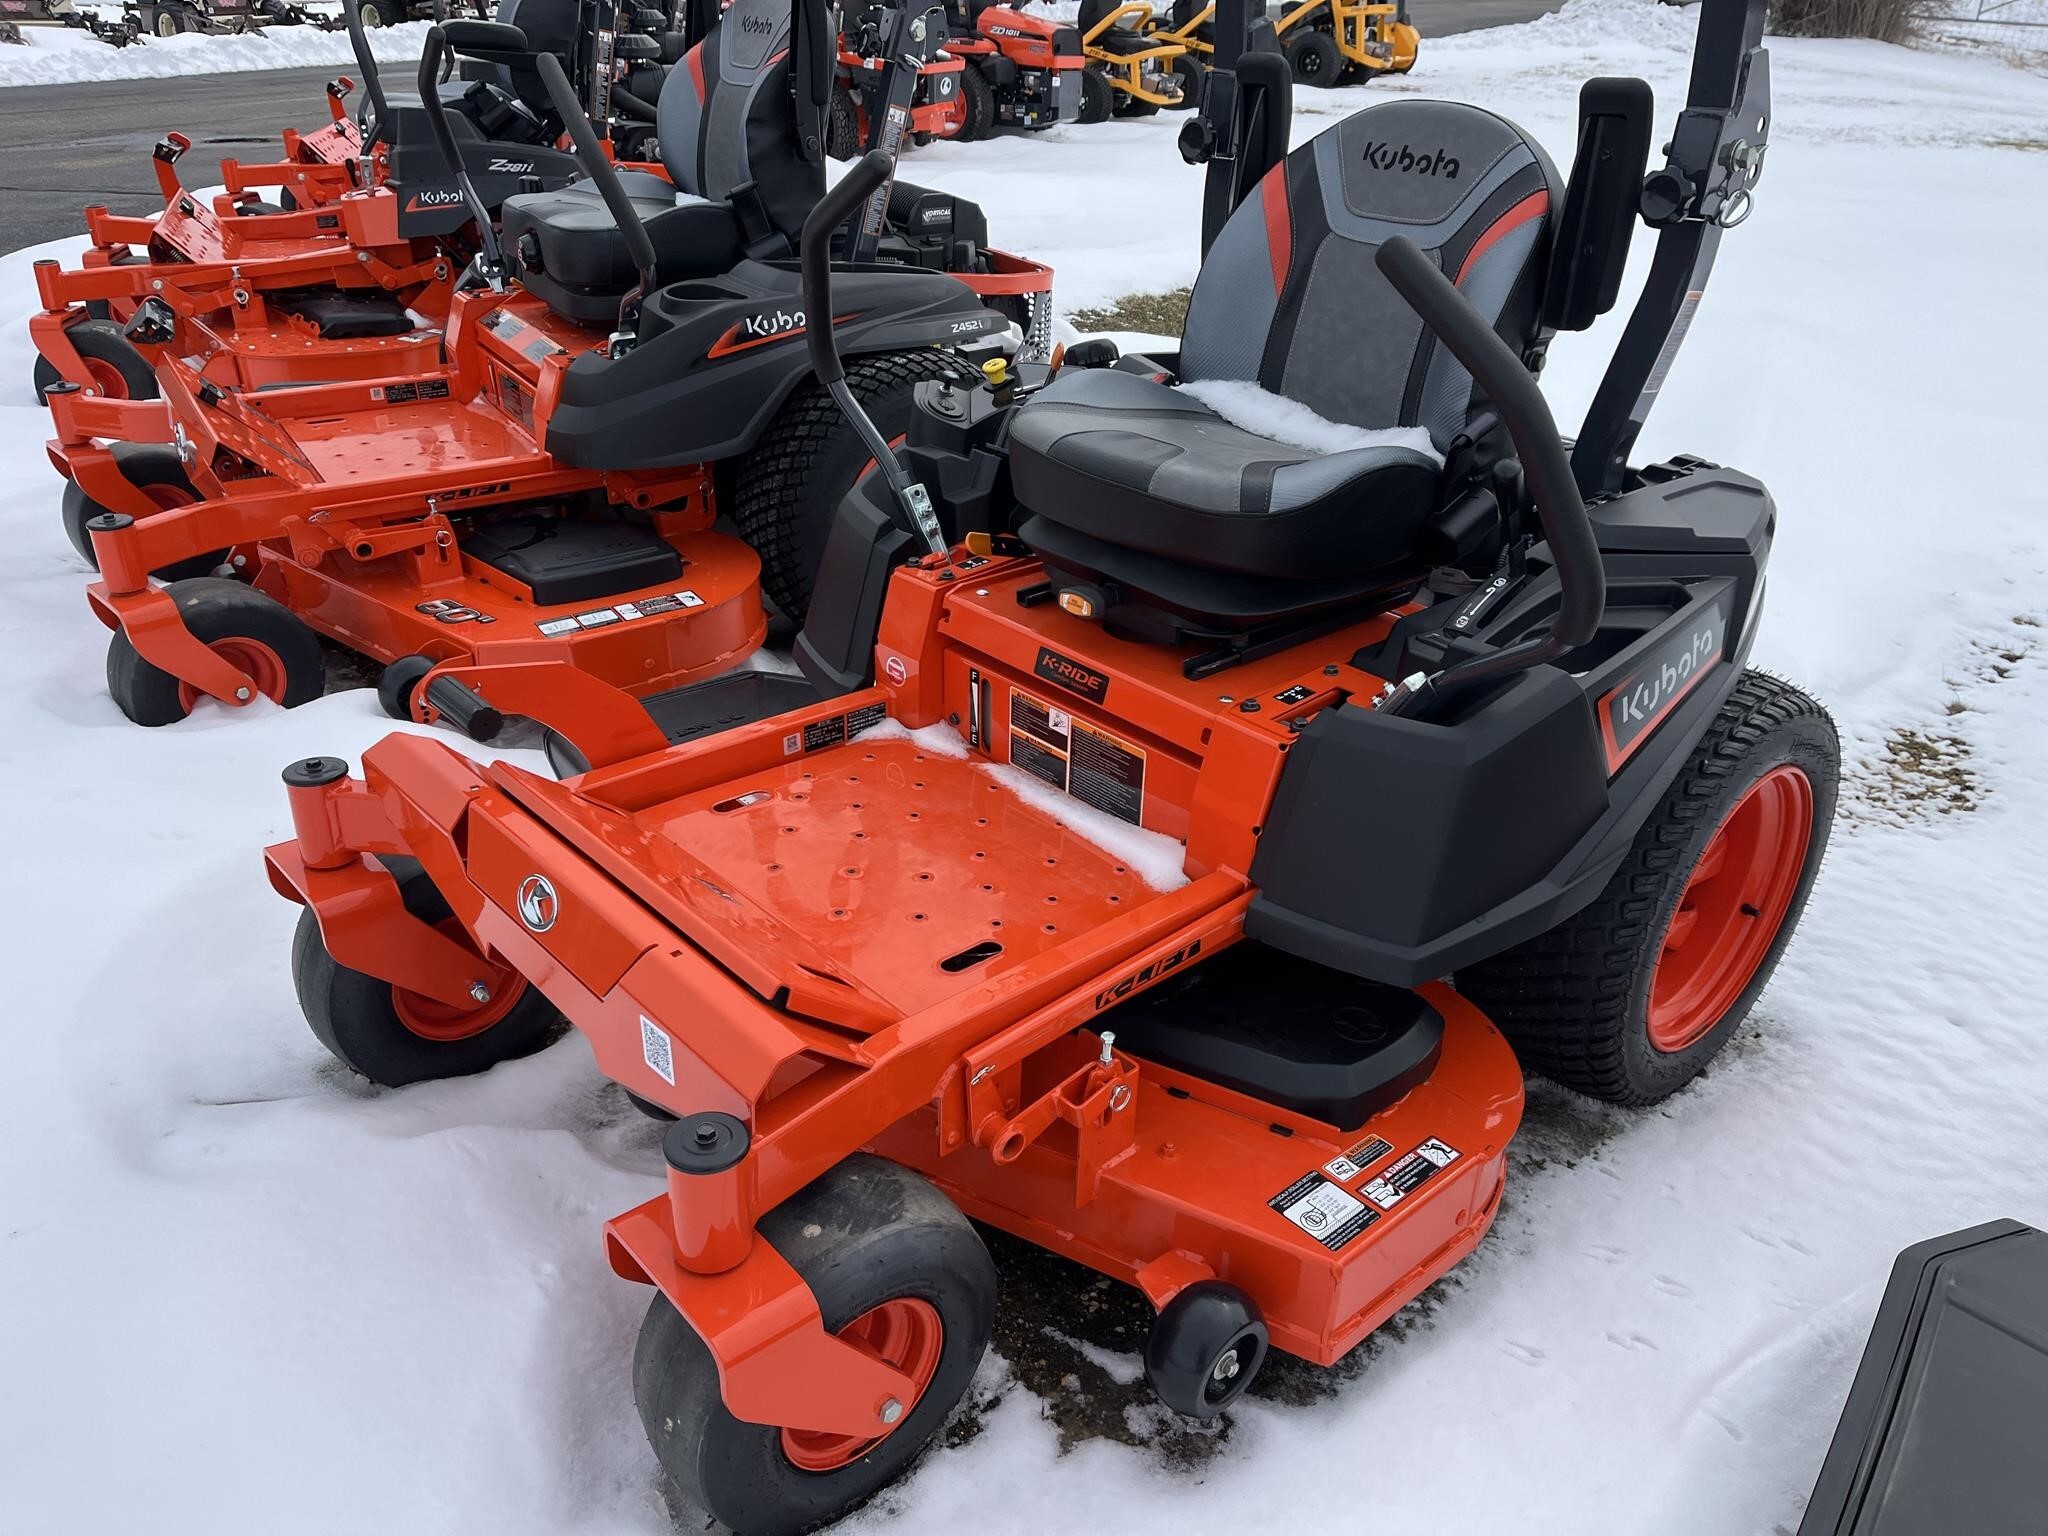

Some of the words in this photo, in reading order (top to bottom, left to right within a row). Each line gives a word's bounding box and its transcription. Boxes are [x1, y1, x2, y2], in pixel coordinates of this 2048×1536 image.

[741, 15, 772, 35] Kubota
[1362, 141, 1460, 179] Kubota
[420, 189, 465, 204] Kubot
[745, 309, 806, 336] Kubo
[951, 319, 983, 334] Z452i
[1042, 654, 1103, 690] K-RIDE
[1622, 629, 1713, 723] Kubota
[1098, 941, 1199, 1009] K-LIFT
[1389, 1152, 1418, 1175] DANGER
